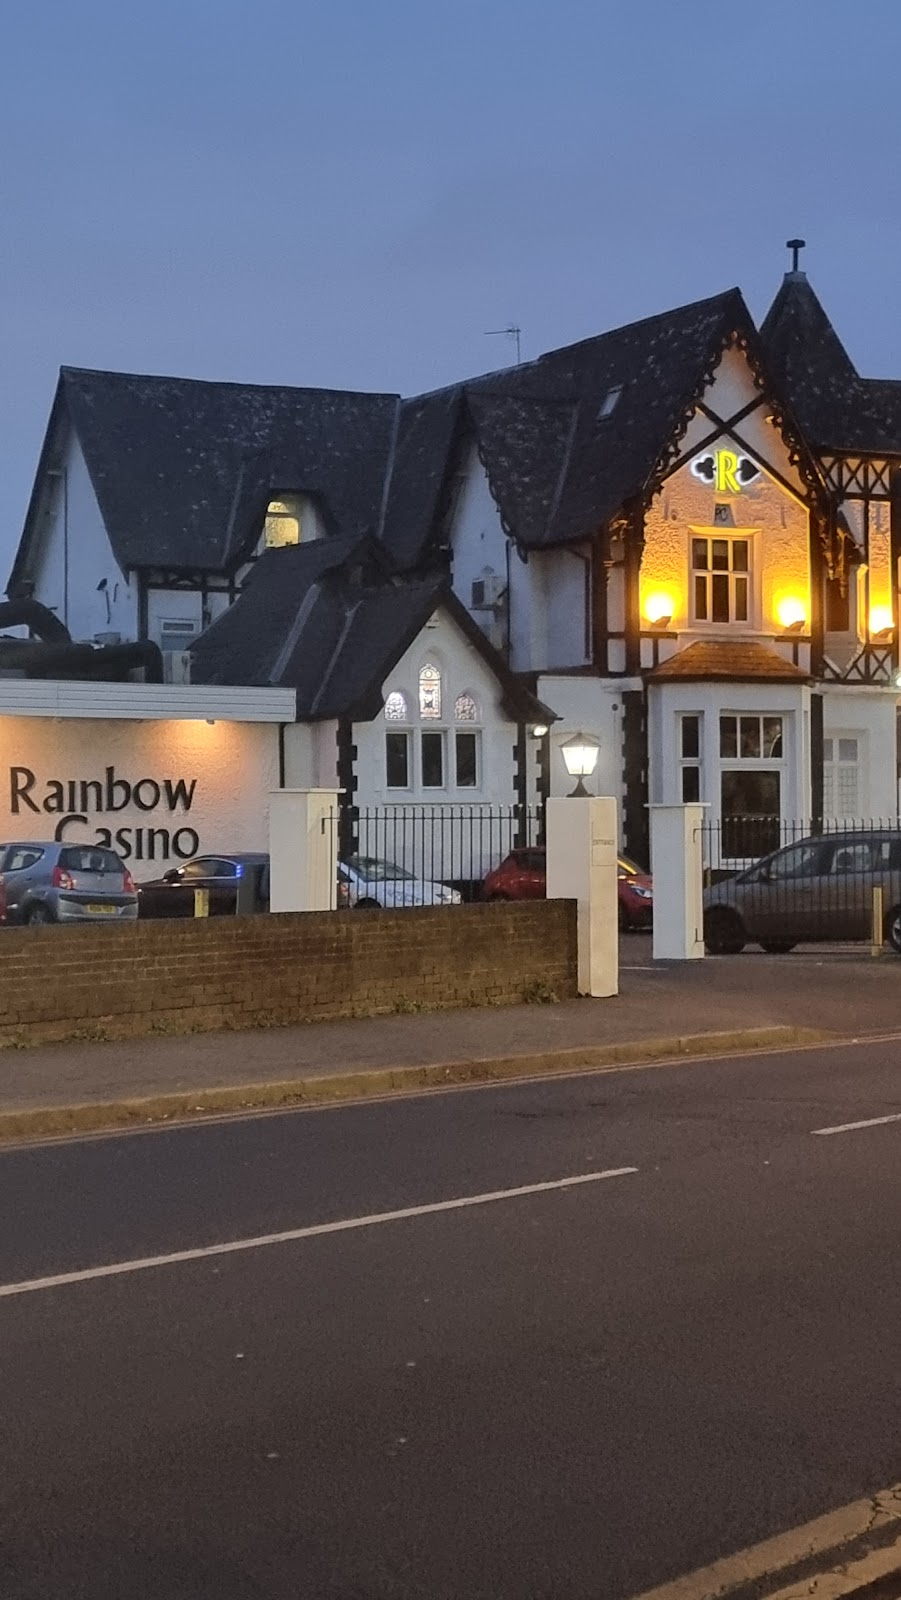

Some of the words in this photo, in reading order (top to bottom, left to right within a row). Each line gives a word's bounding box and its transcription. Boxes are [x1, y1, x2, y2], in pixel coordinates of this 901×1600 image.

[715, 449, 741, 493] R
[10, 766, 198, 813] Rainbow
[54, 814, 200, 860] Casino
